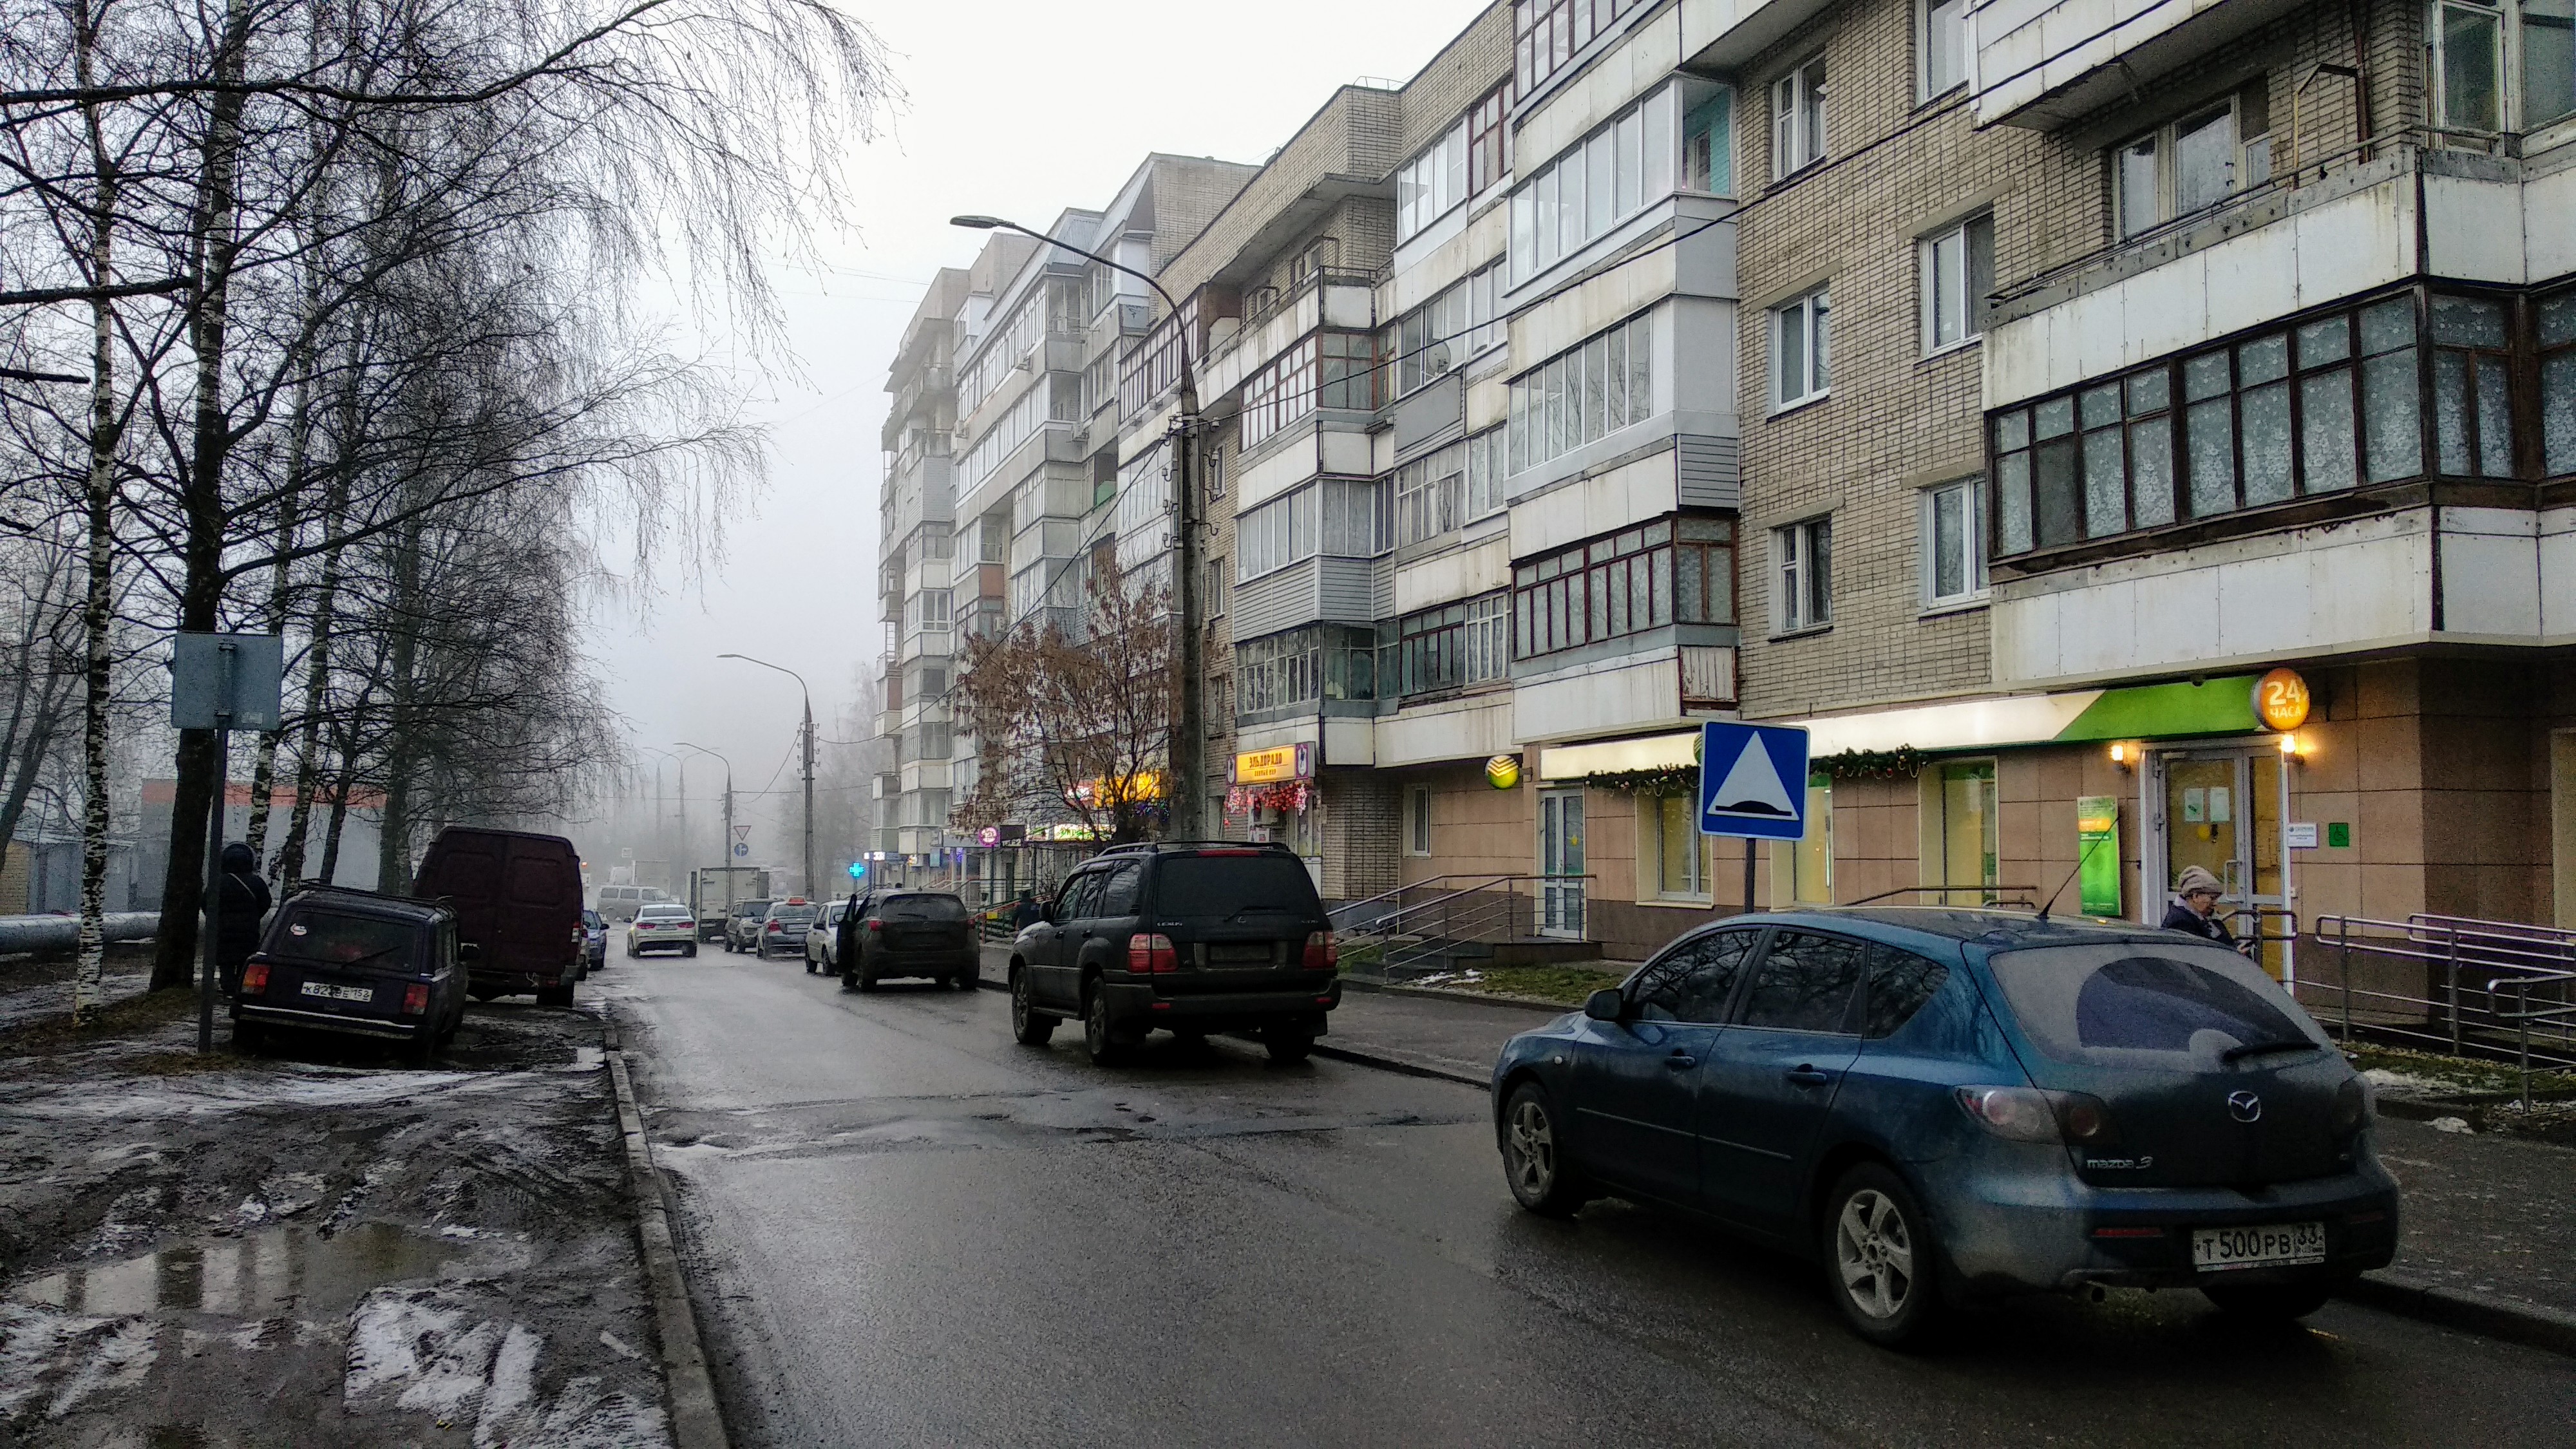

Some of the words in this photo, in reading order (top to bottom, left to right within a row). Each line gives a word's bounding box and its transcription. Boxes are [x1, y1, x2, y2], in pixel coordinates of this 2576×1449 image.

[2267, 679, 2301, 706] 24
[2269, 705, 2302, 719] ЧАСА
[1249, 752, 1282, 768] ЭЛЬДОРАДО
[1002, 838, 1021, 847] TELE2
